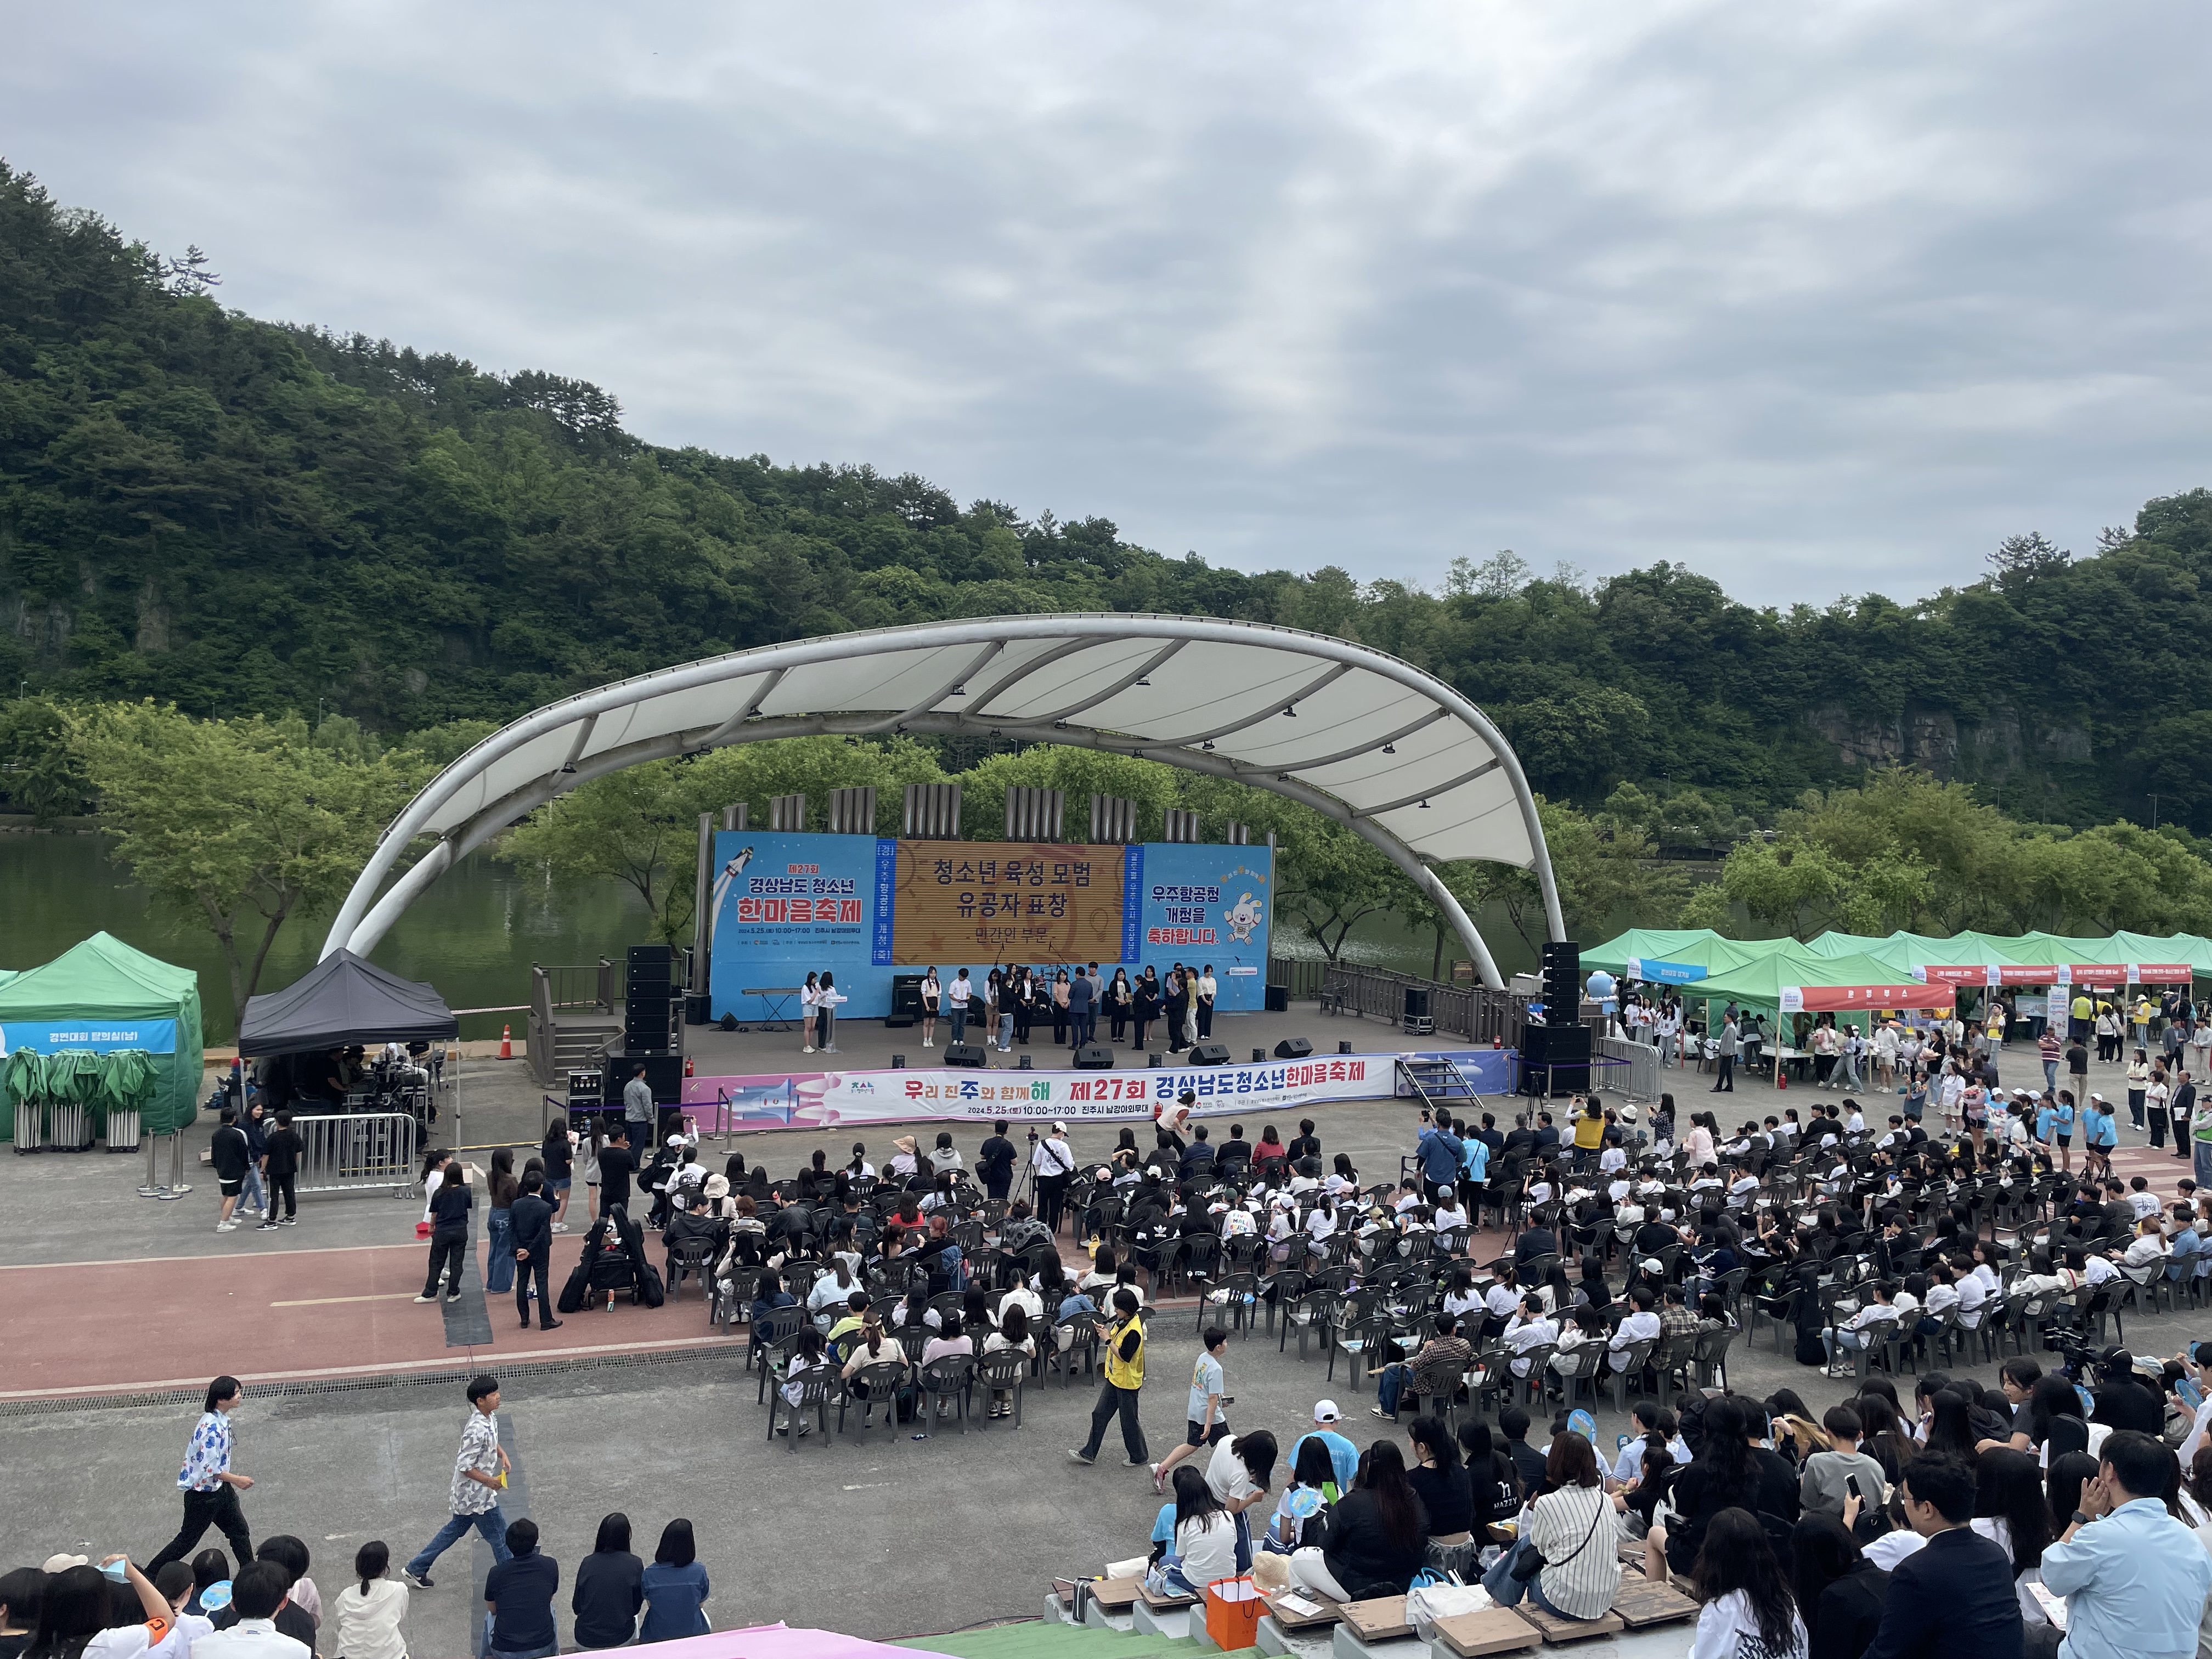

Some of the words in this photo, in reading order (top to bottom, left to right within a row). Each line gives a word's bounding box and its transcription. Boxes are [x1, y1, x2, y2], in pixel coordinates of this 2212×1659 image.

[788, 864, 819, 874] 제27회
[934, 859, 997, 885] 청소년
[1004, 861, 1044, 887] 육성
[1051, 861, 1091, 887] 모범
[750, 878, 808, 894] 경상남도
[812, 878, 855, 895] 청소년
[1151, 885, 1220, 903] 우주항공청
[738, 896, 862, 923] 한마음축제
[956, 892, 1020, 918] 유공자
[1026, 892, 1068, 918] 표창
[1165, 906, 1205, 924] 개청을
[975, 927, 1015, 944] 민간인
[1020, 927, 1049, 944] 부문
[1148, 927, 1220, 945] 축하합니다.
[91, 1031, 138, 1042] 탈의실(남)
[905, 1080, 938, 1099] 우리
[944, 1081, 995, 1100] 진주와
[1001, 1081, 1050, 1101] 함께해
[1070, 1079, 1146, 1101] 제27회
[968, 1106, 1022, 1115] 2024.5.25.(토)
[1023, 1106, 1076, 1115] 10:00~17:00
[1082, 1105, 1104, 1114] 진주시
[1106, 1104, 1149, 1114] 남강야외무대
[1494, 1496, 1517, 1510] HAZZY
